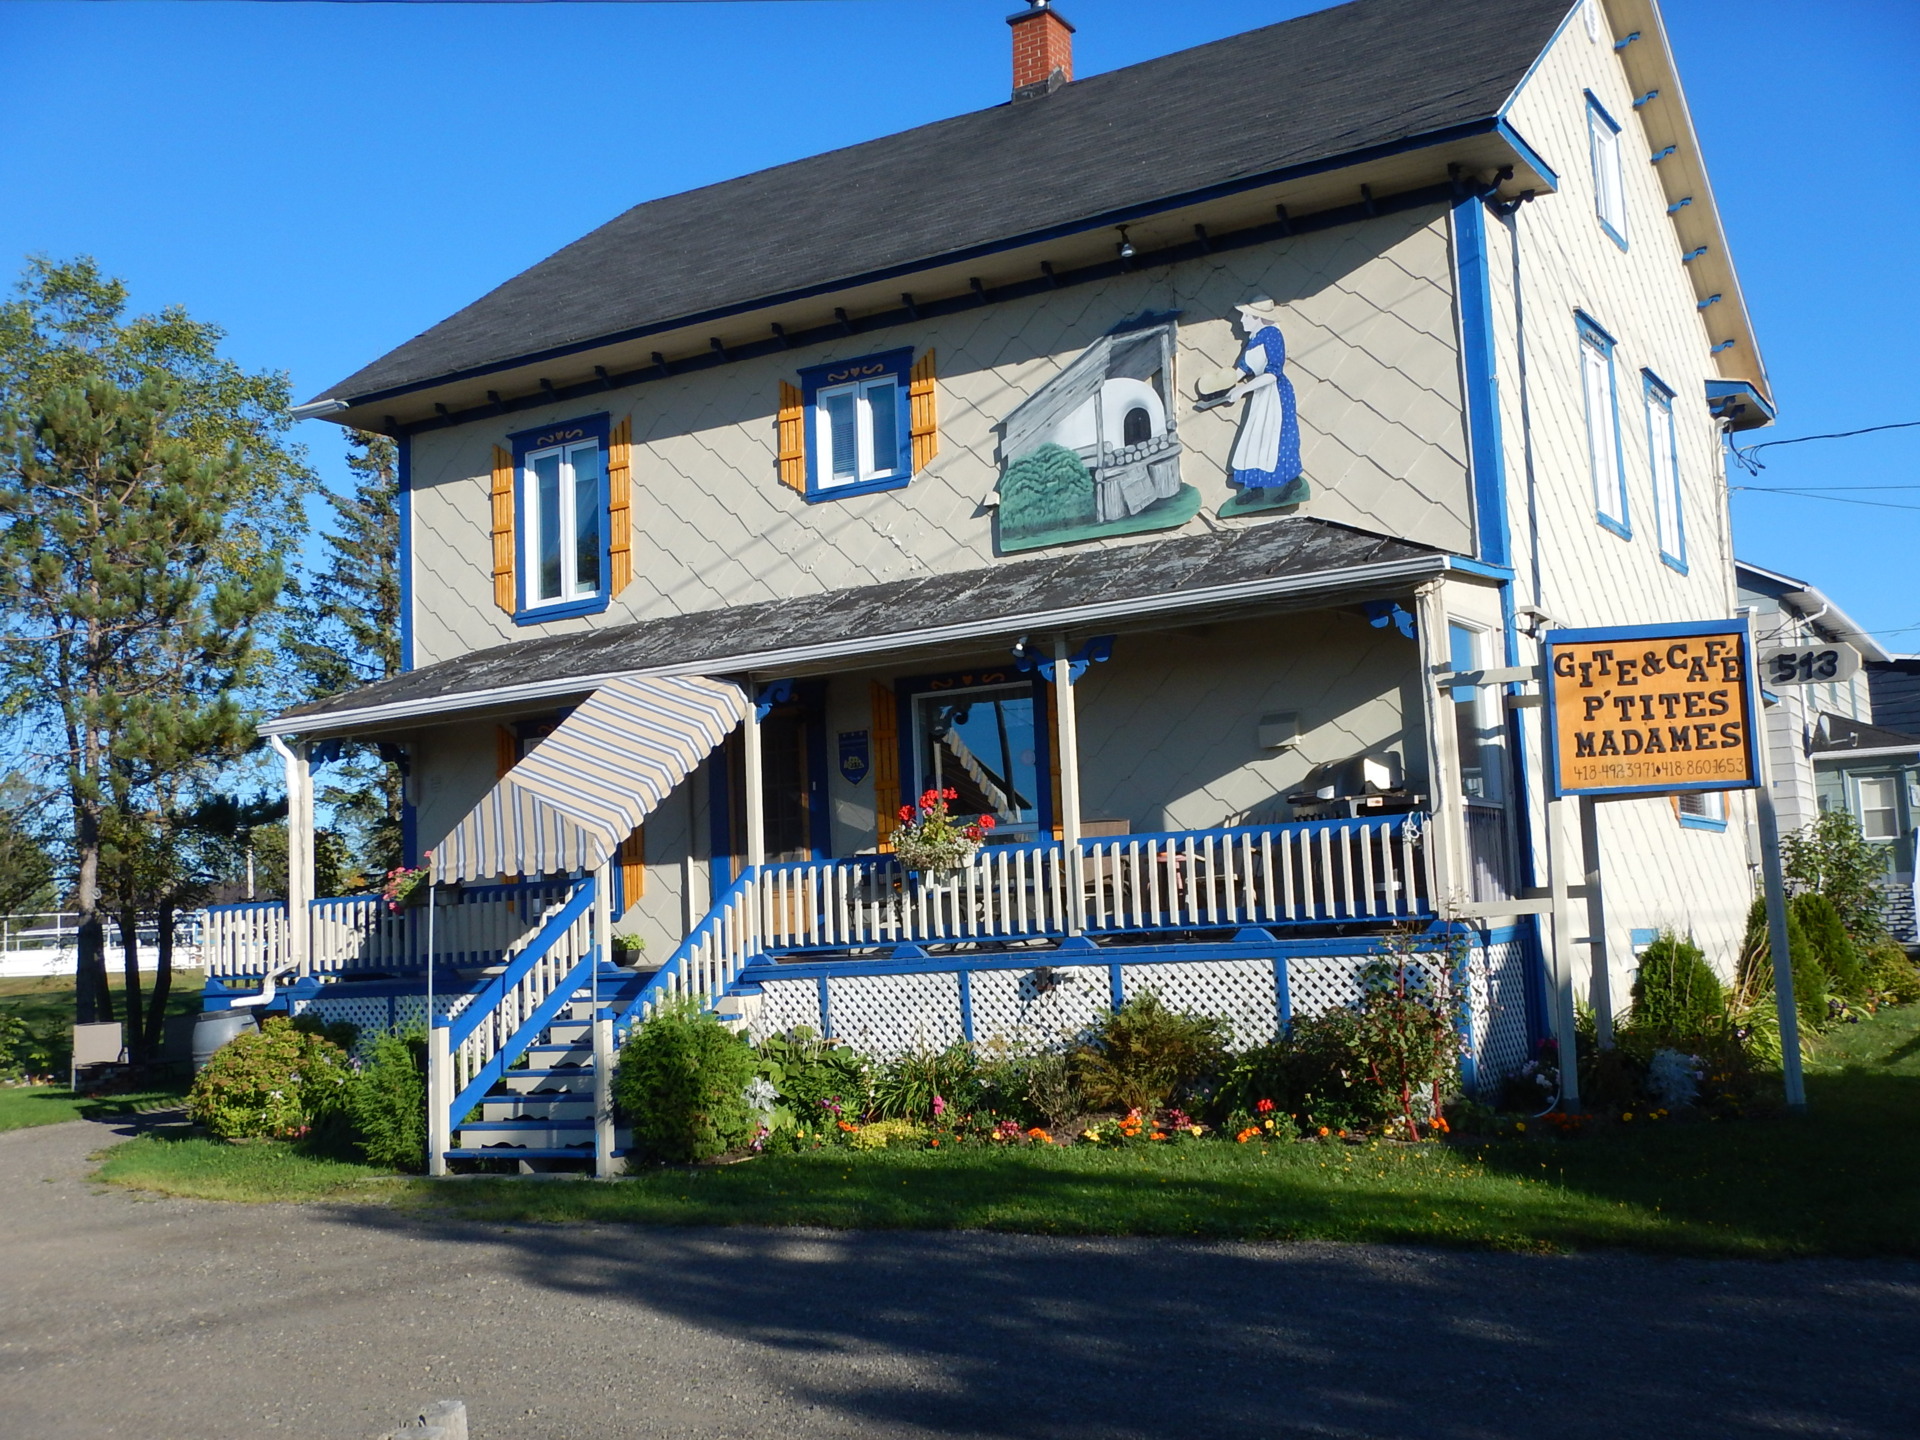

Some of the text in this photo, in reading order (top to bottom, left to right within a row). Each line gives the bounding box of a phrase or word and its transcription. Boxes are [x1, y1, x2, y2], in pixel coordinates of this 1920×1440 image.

[1777, 649, 1839, 682] 513
[1583, 689, 1730, 722] P'TITES
[1574, 721, 1742, 758] MADAMES
